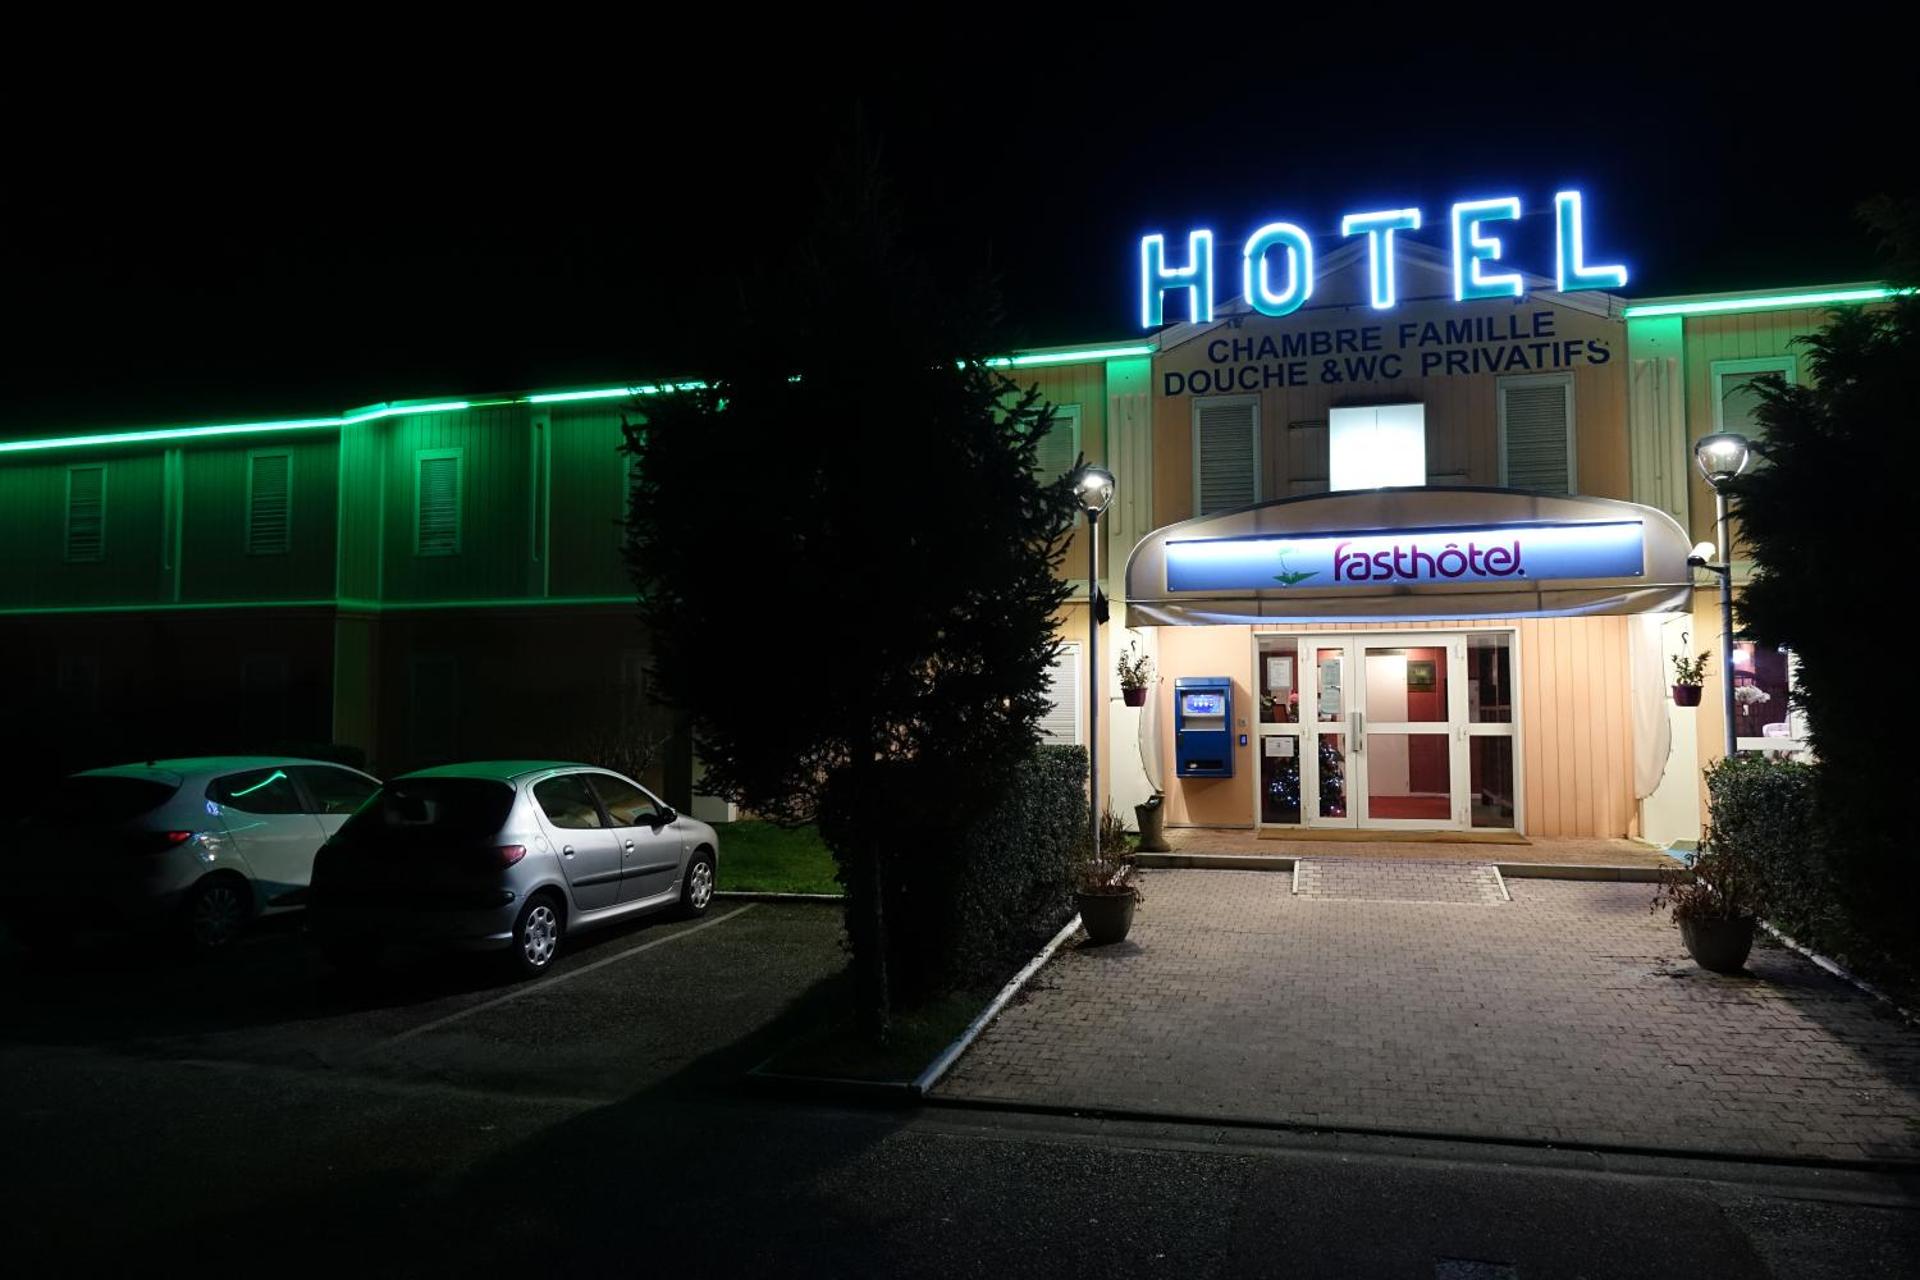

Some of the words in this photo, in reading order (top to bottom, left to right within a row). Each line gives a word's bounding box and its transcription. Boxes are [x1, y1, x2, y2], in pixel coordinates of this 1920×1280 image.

[1140, 190, 1629, 329] HOTEL
[1208, 326, 1382, 364] CHAMBRE
[1399, 311, 1555, 348] FAMILLE
[1164, 362, 1308, 396] DOUCHE
[1421, 338, 1611, 377] PRIVATIFS
